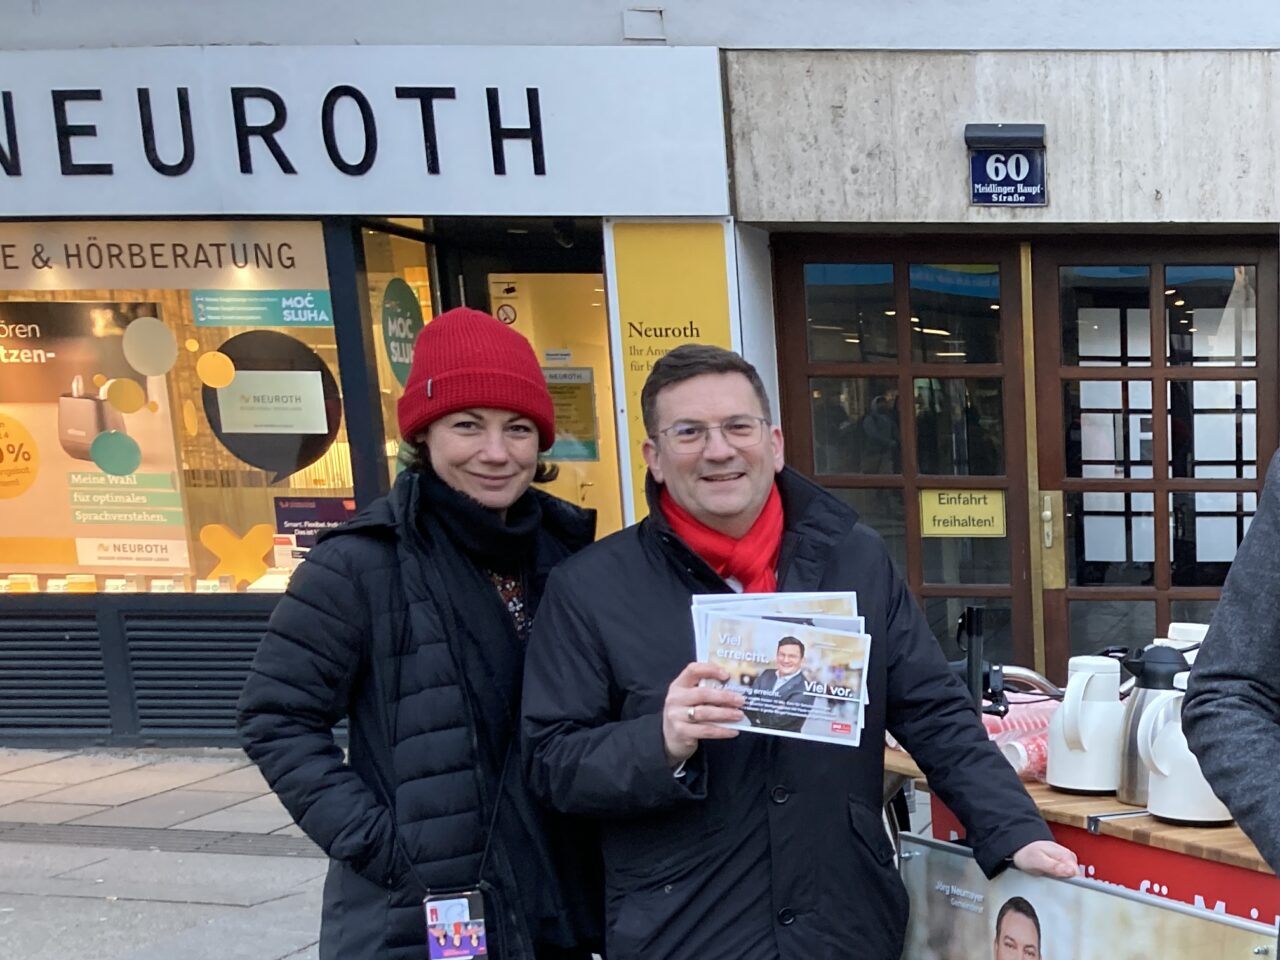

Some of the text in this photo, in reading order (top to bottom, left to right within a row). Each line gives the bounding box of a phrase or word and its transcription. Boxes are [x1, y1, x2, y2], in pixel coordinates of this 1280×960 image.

[986, 153, 1029, 182] 60
[974, 183, 1015, 194] Meidlinger
[991, 193, 1026, 202] Straße
[31, 243, 52, 269] &
[64, 236, 296, 269] HÖRBERATUNG
[283, 309, 329, 321] SLUHA
[628, 321, 700, 338] Neuroth
[629, 345, 645, 356] Ihr
[630, 361, 644, 372] für
[253, 394, 302, 403] NEUROTH
[71, 474, 105, 484] Meine
[73, 492, 148, 504] für optimales
[938, 492, 988, 505] Einfahrt
[932, 515, 994, 527] freihalten!
[113, 543, 169, 554] NEUROTH
[719, 633, 742, 646] Viel
[803, 680, 853, 697] Viel vor.
